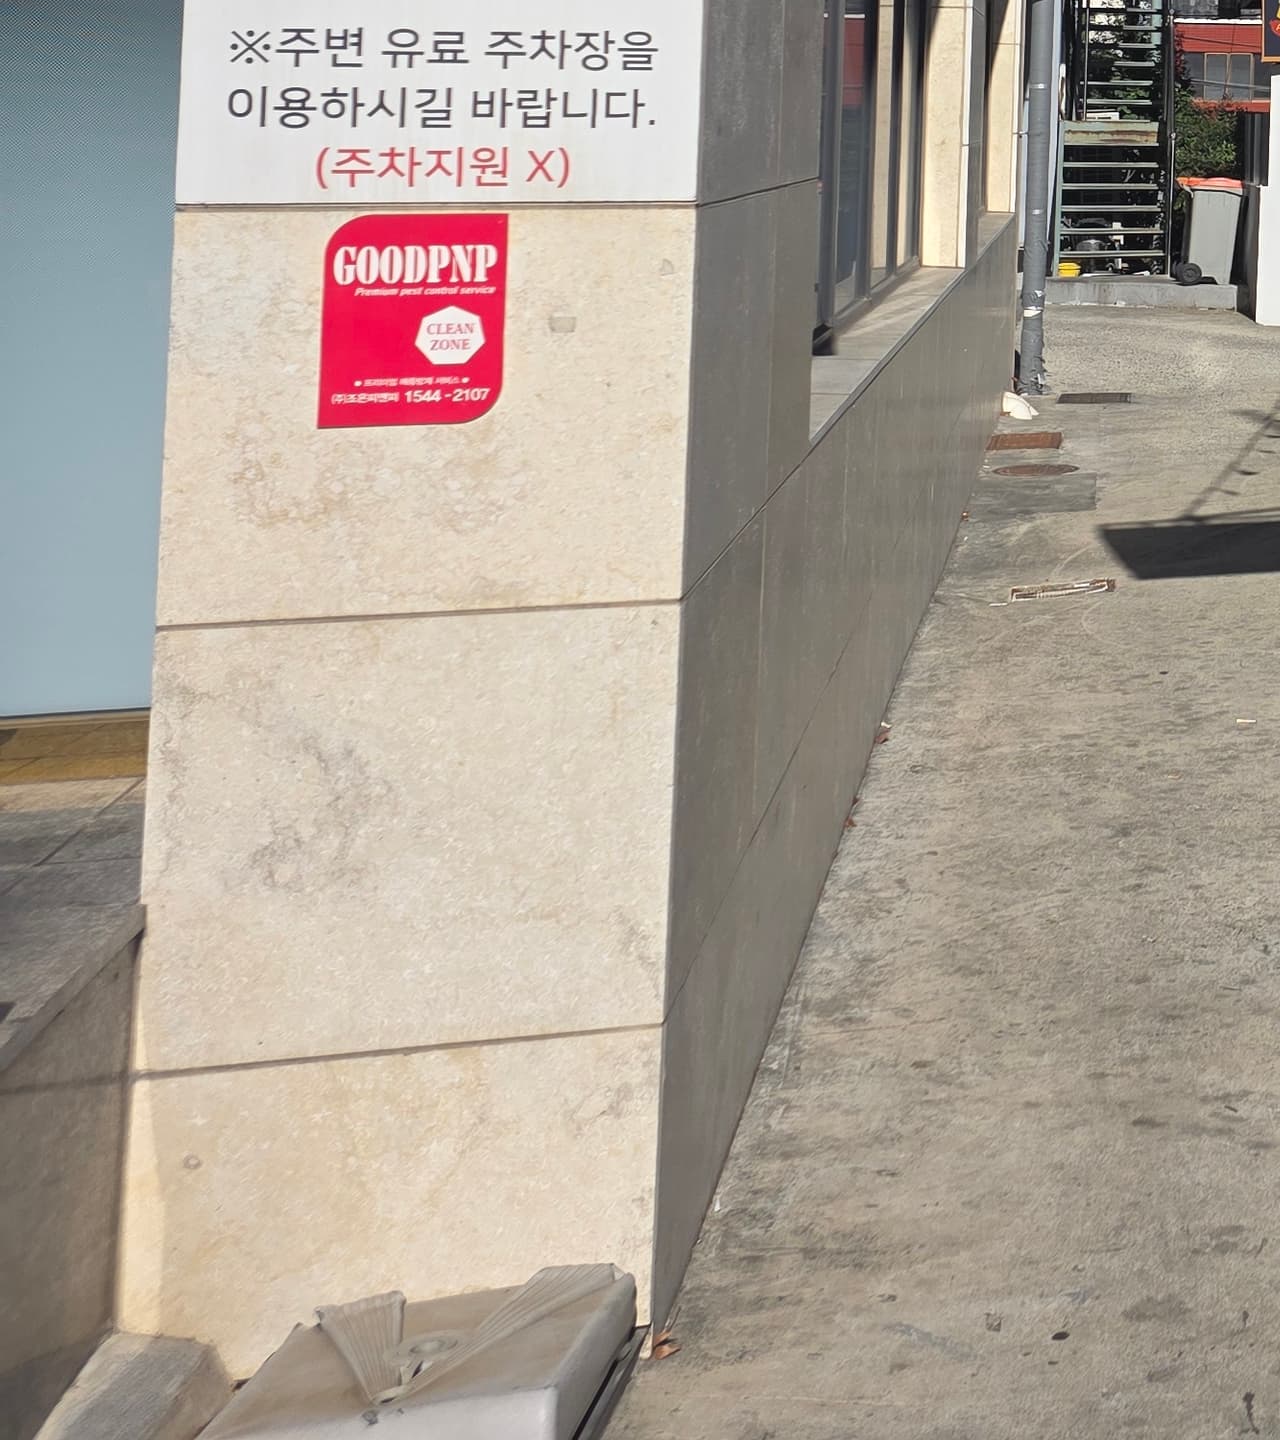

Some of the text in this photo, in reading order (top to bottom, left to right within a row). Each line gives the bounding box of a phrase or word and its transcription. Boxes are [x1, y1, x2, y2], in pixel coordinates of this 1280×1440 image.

[381, 28, 469, 67] 유료
[484, 29, 659, 72] 주차장을
[227, 85, 656, 129] 이용하시길 바랍니다.
[316, 146, 571, 190] (주차지원 X)
[333, 244, 498, 285] GOODPNP
[426, 323, 475, 335] CLEAN
[430, 339, 471, 351] ZONE
